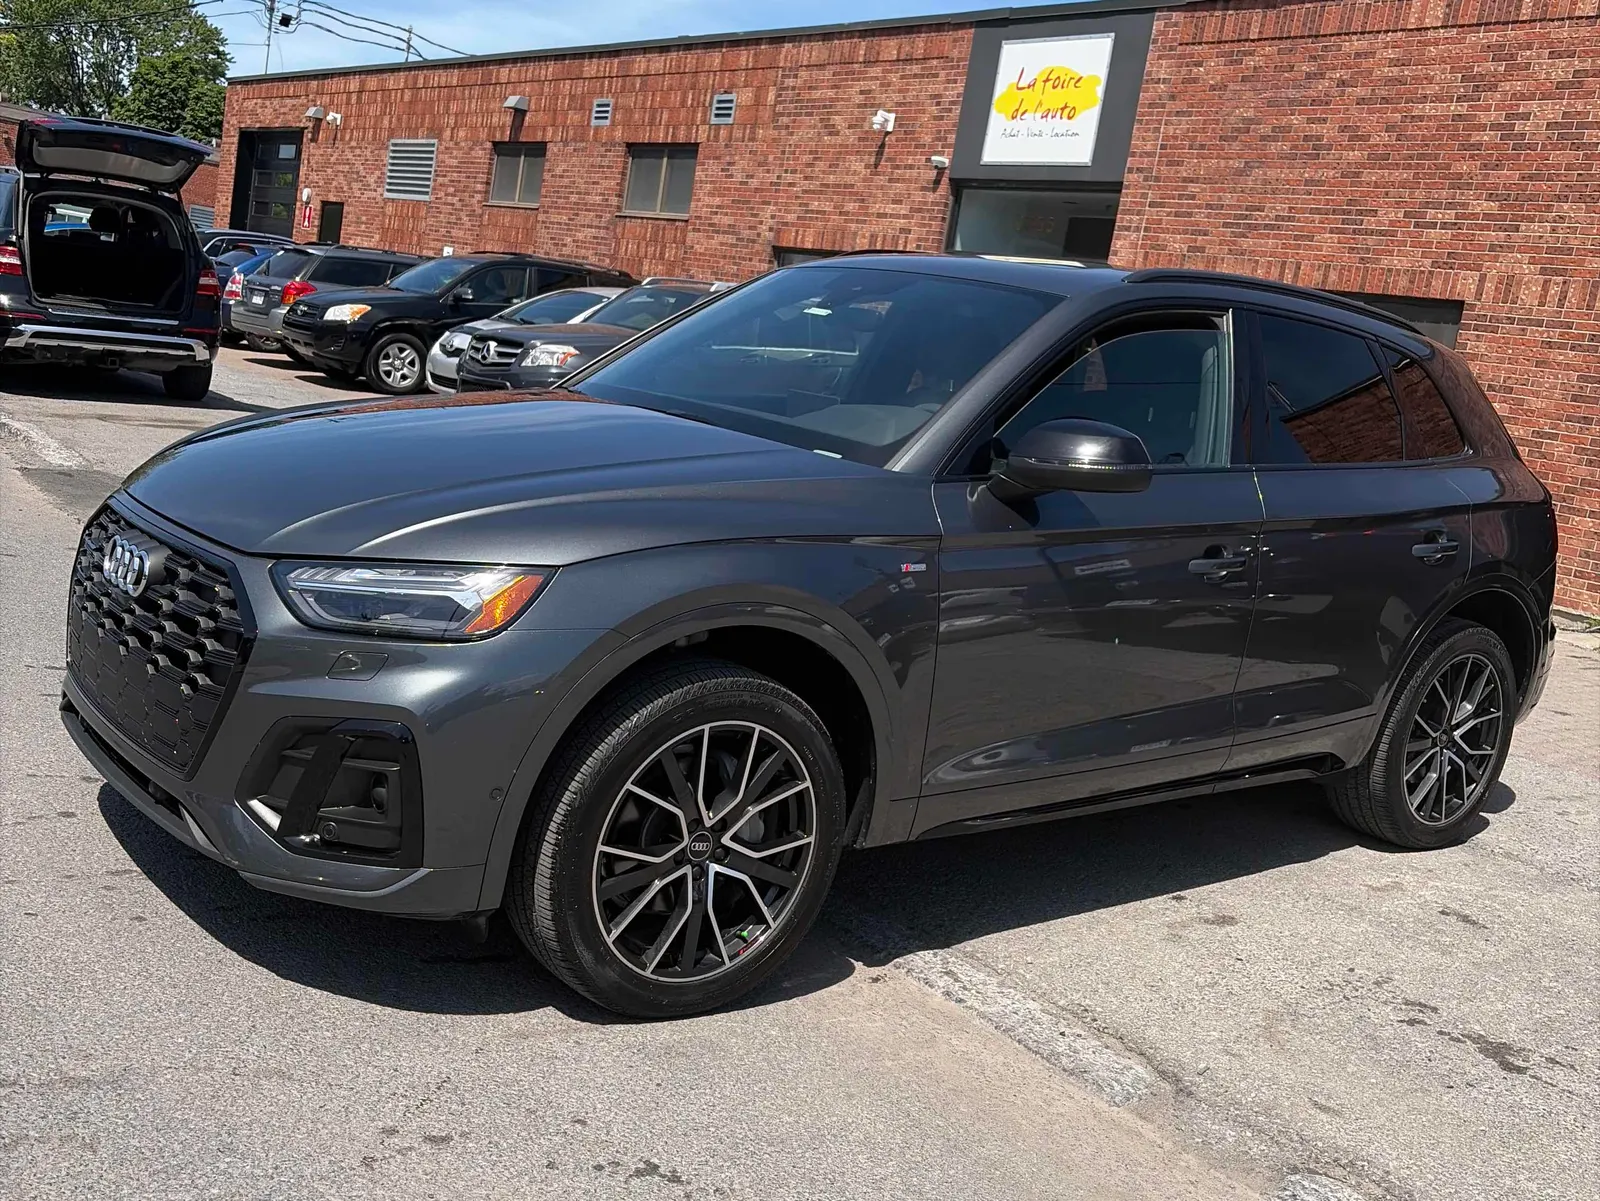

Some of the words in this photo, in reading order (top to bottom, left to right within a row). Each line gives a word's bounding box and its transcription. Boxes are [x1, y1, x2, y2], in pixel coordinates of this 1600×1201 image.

[1016, 66, 1036, 92] La
[1041, 68, 1084, 96] foire
[1011, 98, 1028, 122] de
[1034, 100, 1077, 123] l'auto
